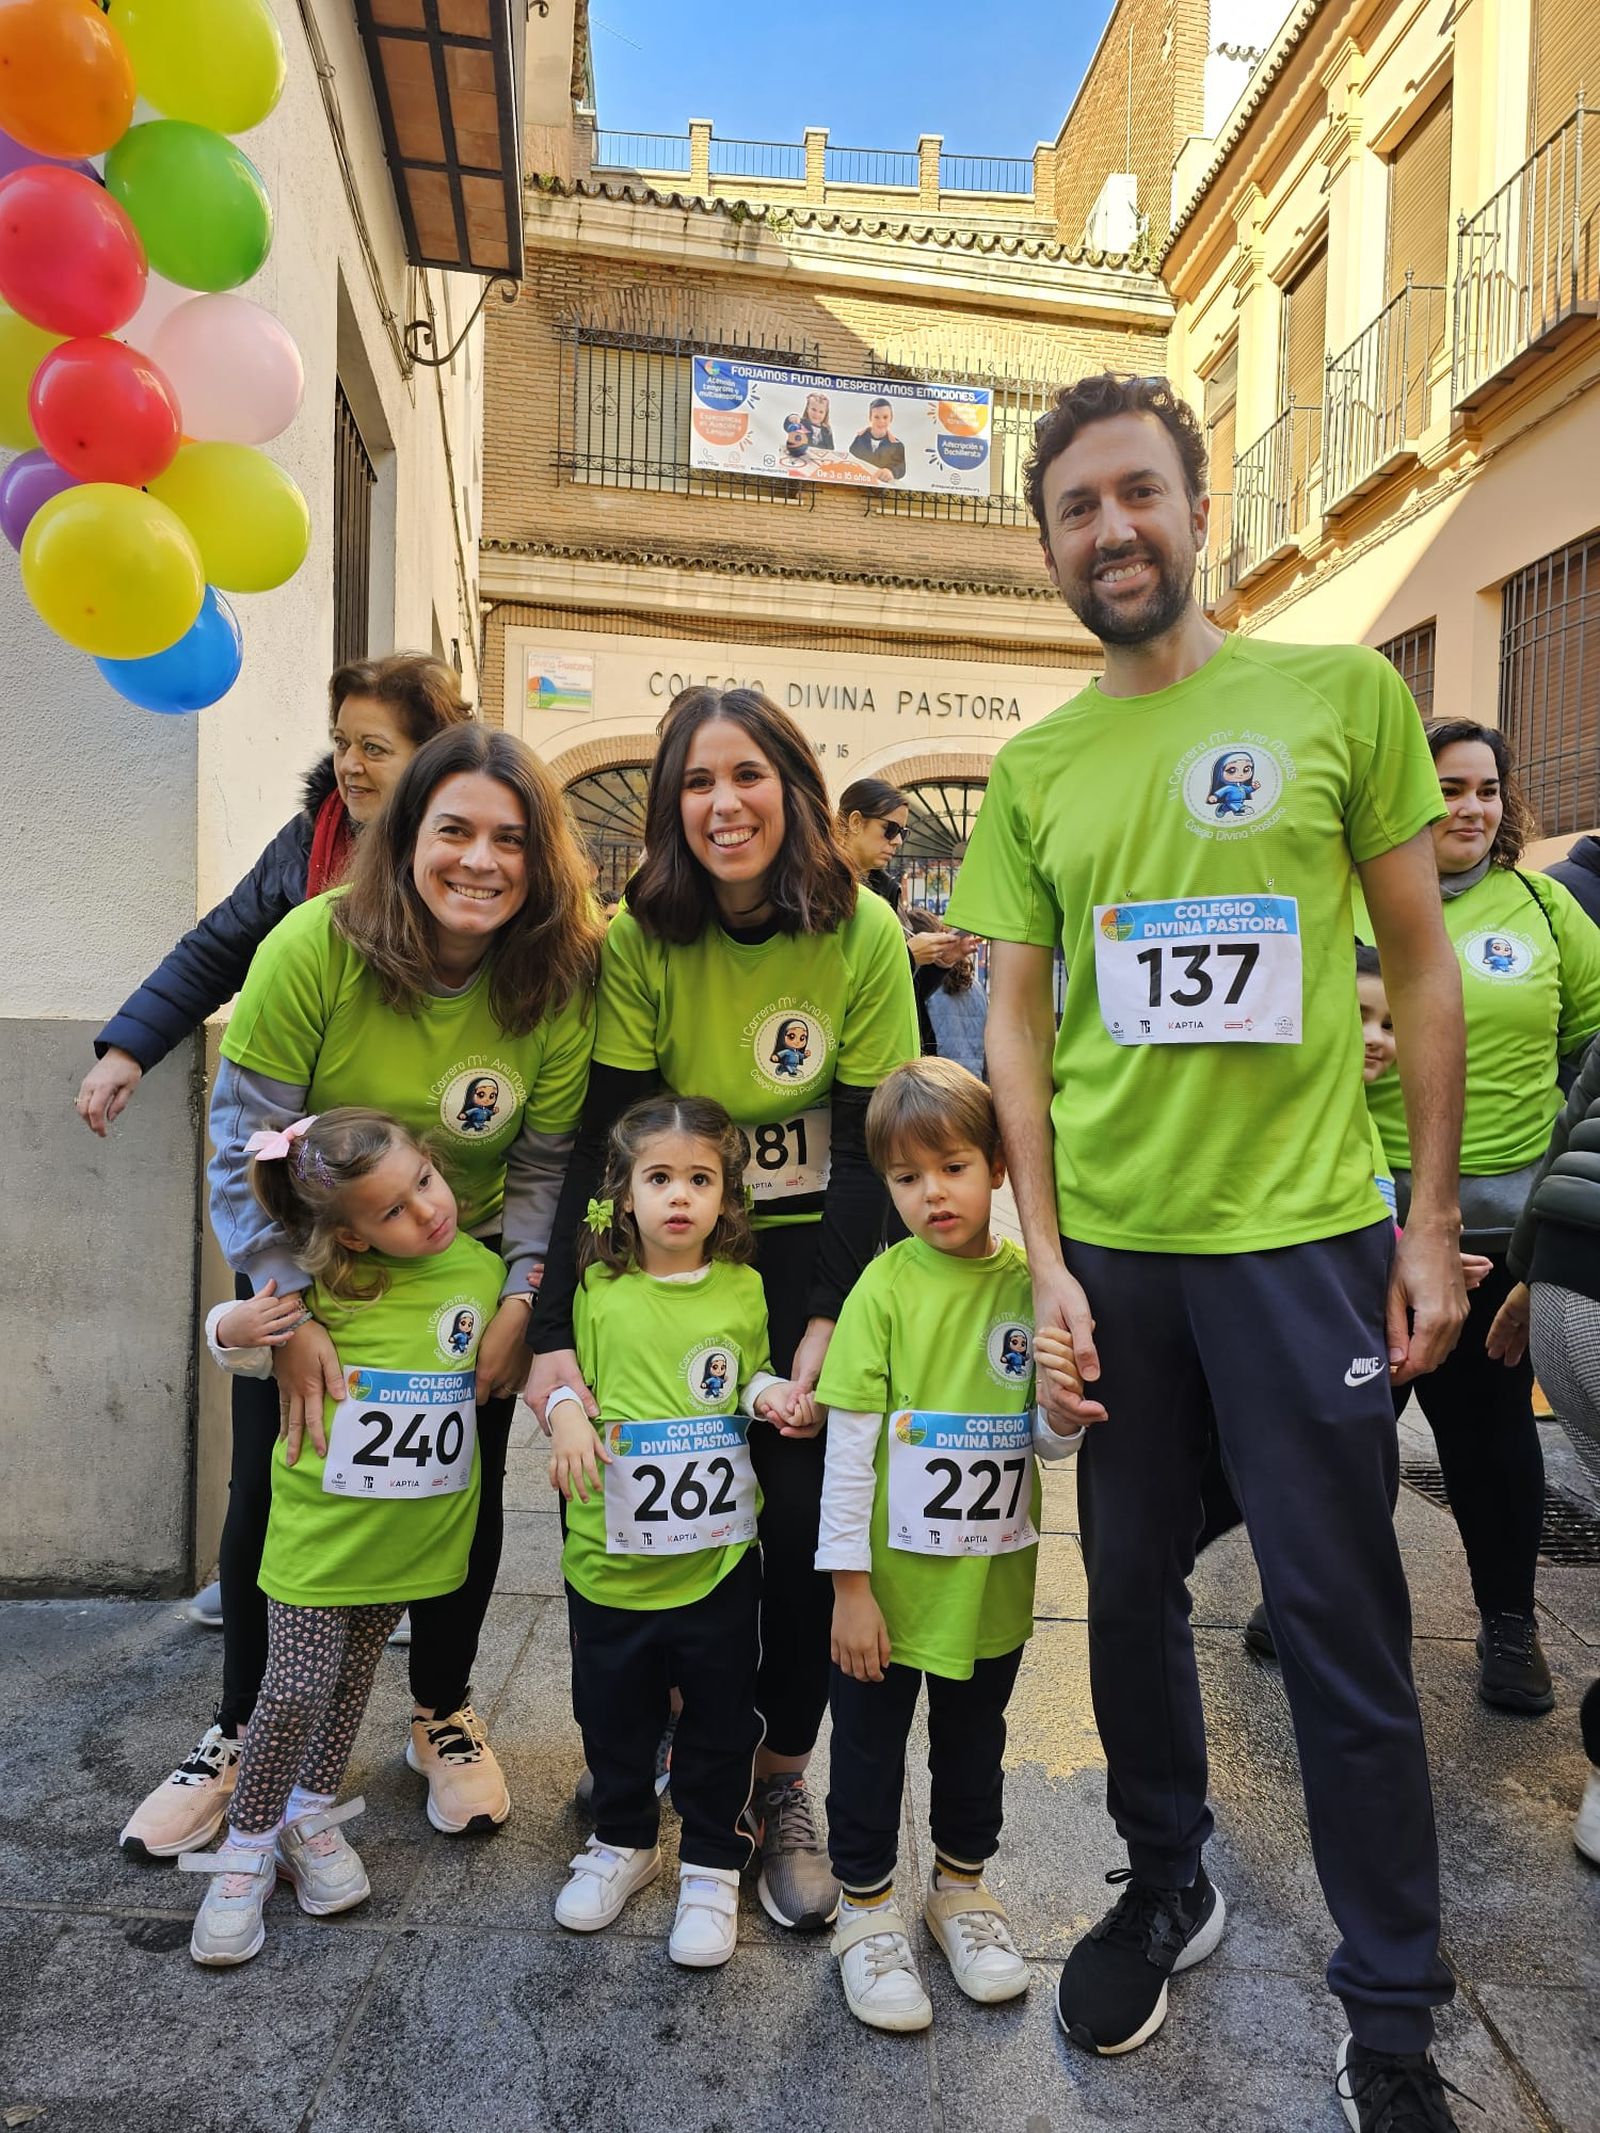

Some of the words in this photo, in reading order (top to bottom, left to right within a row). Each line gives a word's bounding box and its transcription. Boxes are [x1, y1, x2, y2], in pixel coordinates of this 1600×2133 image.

[731, 366, 788, 382] FORJAMOS
[791, 373, 834, 387] FUTURO.
[836, 379, 914, 396] DESPERTAMOS
[916, 388, 978, 402] EMOCIONES.
[788, 682, 876, 713] DIVINA
[897, 690, 1021, 722] PASTORA
[1169, 742, 1208, 785] Carrera
[1240, 730, 1268, 745] Ana
[1186, 818, 1214, 840] Colegio
[1216, 830, 1249, 842] Divina
[1250, 806, 1287, 836] Pastora
[1174, 901, 1256, 920] COLEGIO
[1143, 920, 1204, 937] DIVINA
[1206, 917, 1289, 933] PASTORA
[1136, 943, 1260, 1008] 137
[743, 1003, 776, 1037] Carrera
[800, 1000, 820, 1017] Ana
[820, 1013, 837, 1052] Mogas
[1168, 1020, 1204, 1031] KAPTIA
[431, 1061, 466, 1095] Carrera
[491, 1058, 511, 1075] Ana
[510, 1071, 528, 1106] Moga
[750, 1069, 773, 1091] Colegio
[774, 1086, 798, 1096] Divina
[750, 1182, 773, 1190] PTIA
[1351, 1357, 1379, 1375] NIKE
[408, 1376, 463, 1390] COLEGIO
[379, 1389, 430, 1402] DIVINA
[667, 1419, 724, 1437] COLEGIO
[965, 1418, 1024, 1433] COLEGIO
[352, 1411, 464, 1467] 240
[640, 1438, 691, 1455] DIVINA
[693, 1431, 742, 1450] PASTORA
[936, 1434, 990, 1448] DIVINA
[992, 1434, 1032, 1448] PASTO
[389, 1479, 420, 1488] KAPTIA
[631, 1456, 737, 1522] 262
[923, 1457, 1026, 1521] 227
[667, 1533, 698, 1542] KAPTIA
[957, 1535, 988, 1544] KAPTIA
